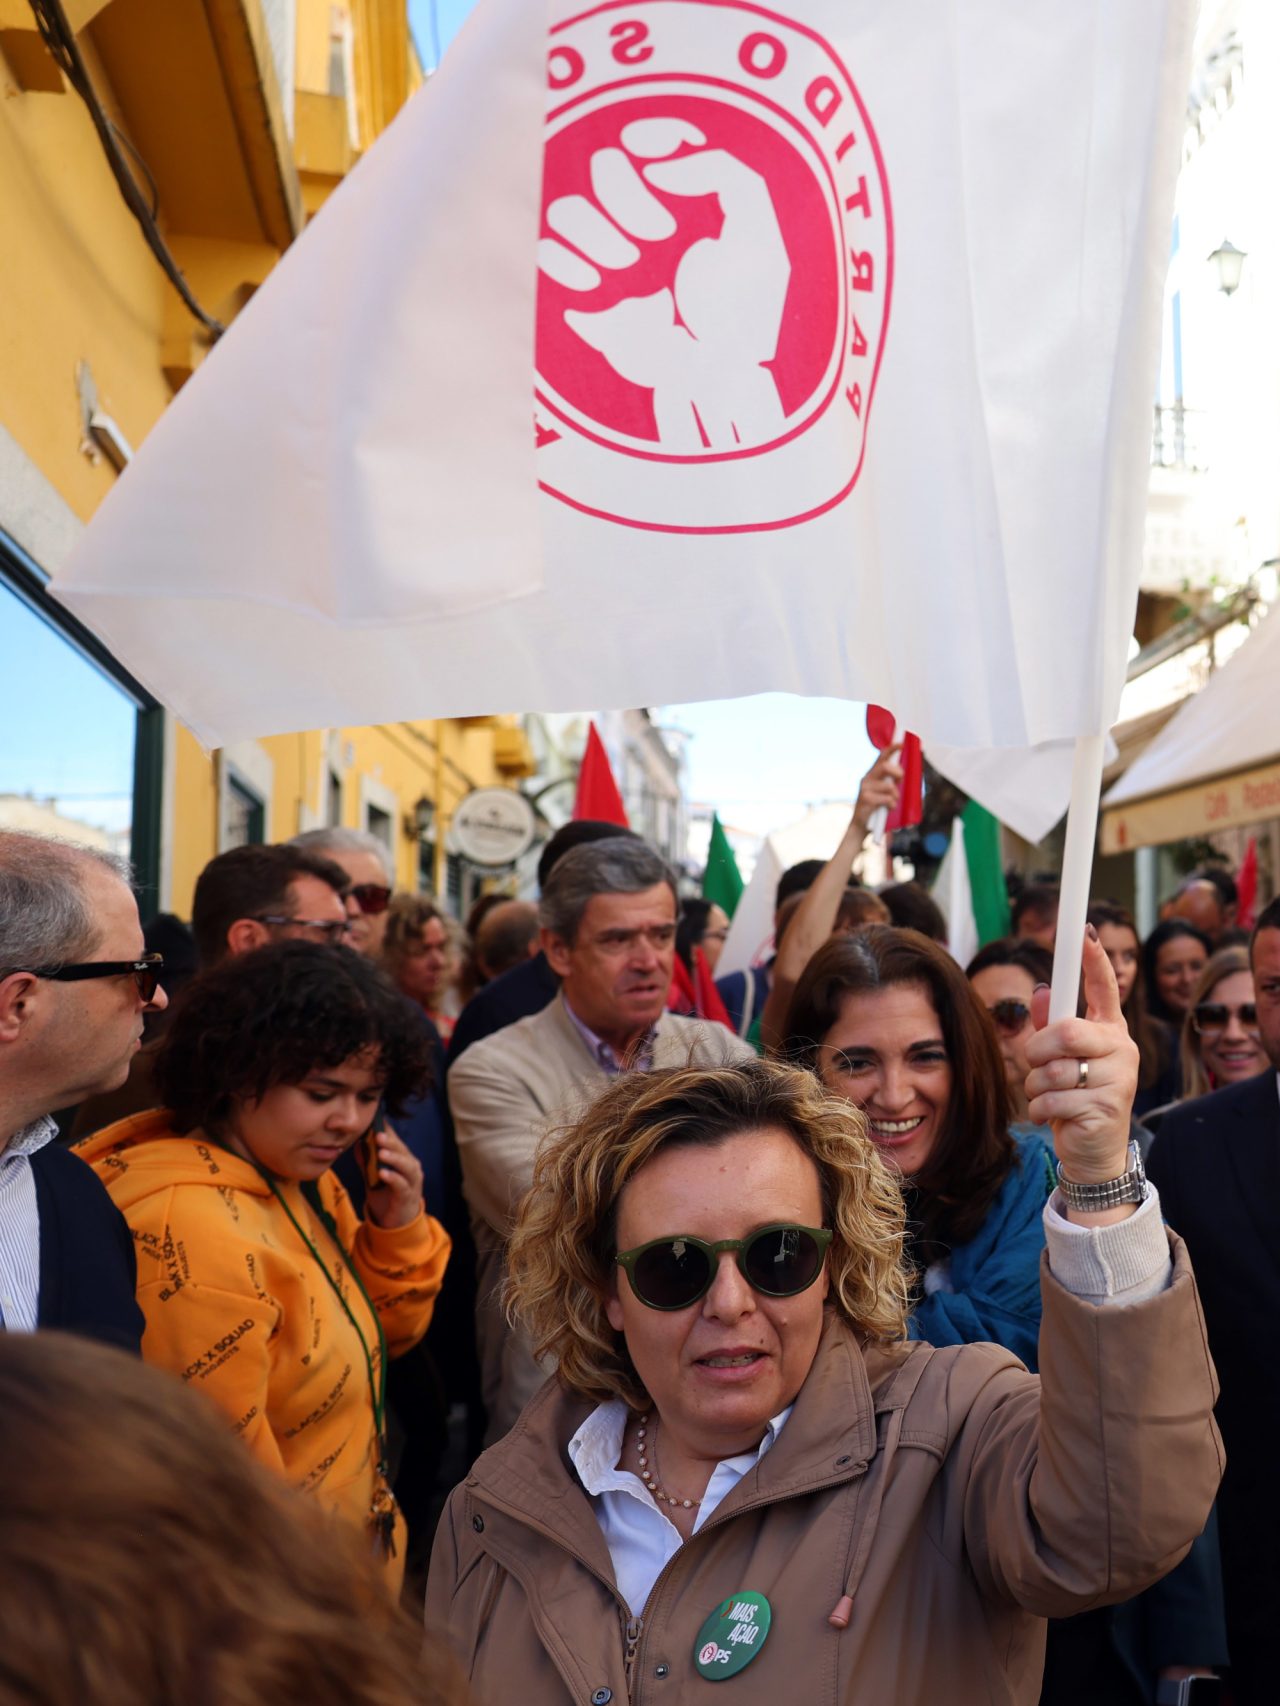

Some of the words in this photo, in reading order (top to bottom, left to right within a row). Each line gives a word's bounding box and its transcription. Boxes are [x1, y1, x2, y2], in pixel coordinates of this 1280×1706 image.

[204, 1351, 218, 1362] X
[214, 1318, 256, 1351] SQUAD
[200, 1346, 240, 1379] PROJECTS
[728, 1602, 758, 1622] MAIS
[714, 1649, 732, 1663] PS
